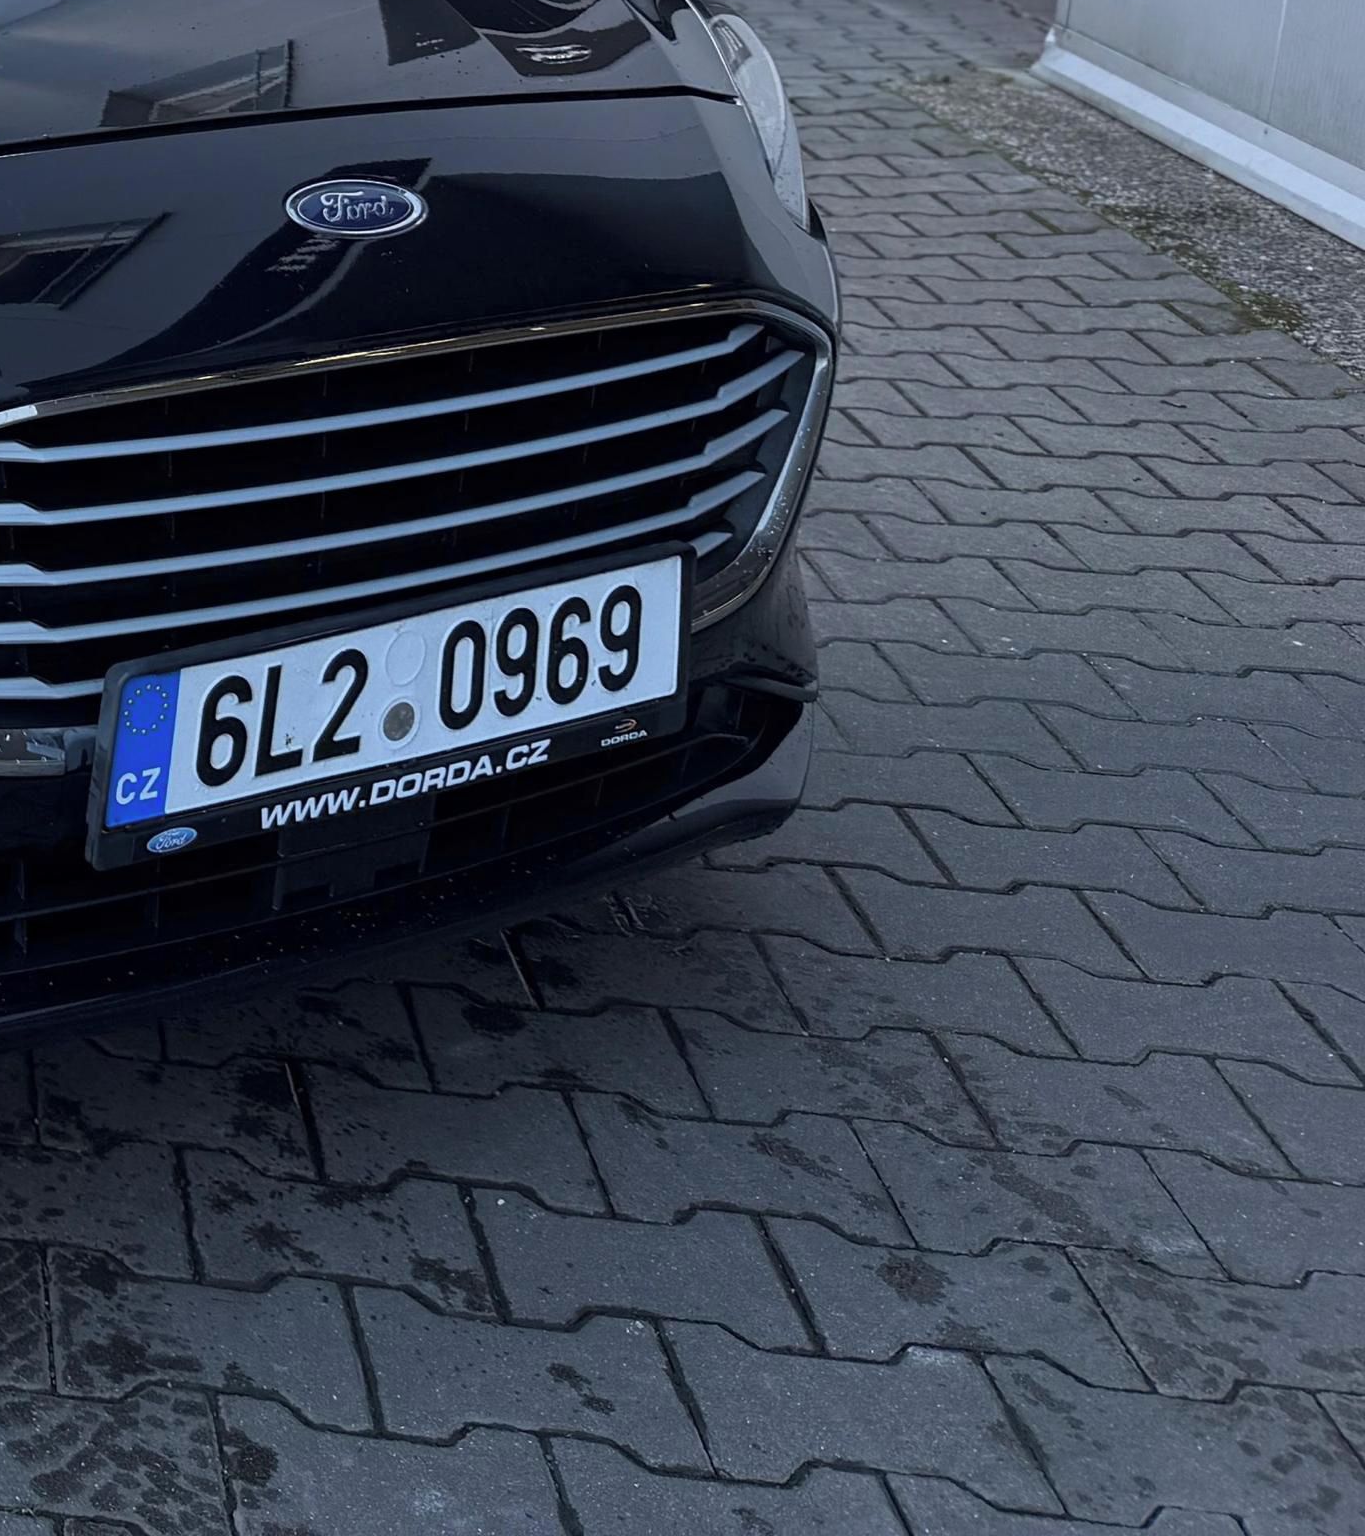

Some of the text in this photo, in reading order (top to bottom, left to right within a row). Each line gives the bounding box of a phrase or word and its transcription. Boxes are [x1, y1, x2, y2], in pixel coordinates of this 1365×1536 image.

[319, 190, 396, 223] Ford
[194, 583, 643, 788] 6L2 0969
[600, 729, 649, 747] DORDA
[115, 765, 161, 805] CZ
[261, 739, 552, 829] WWW.DORDA.CZ
